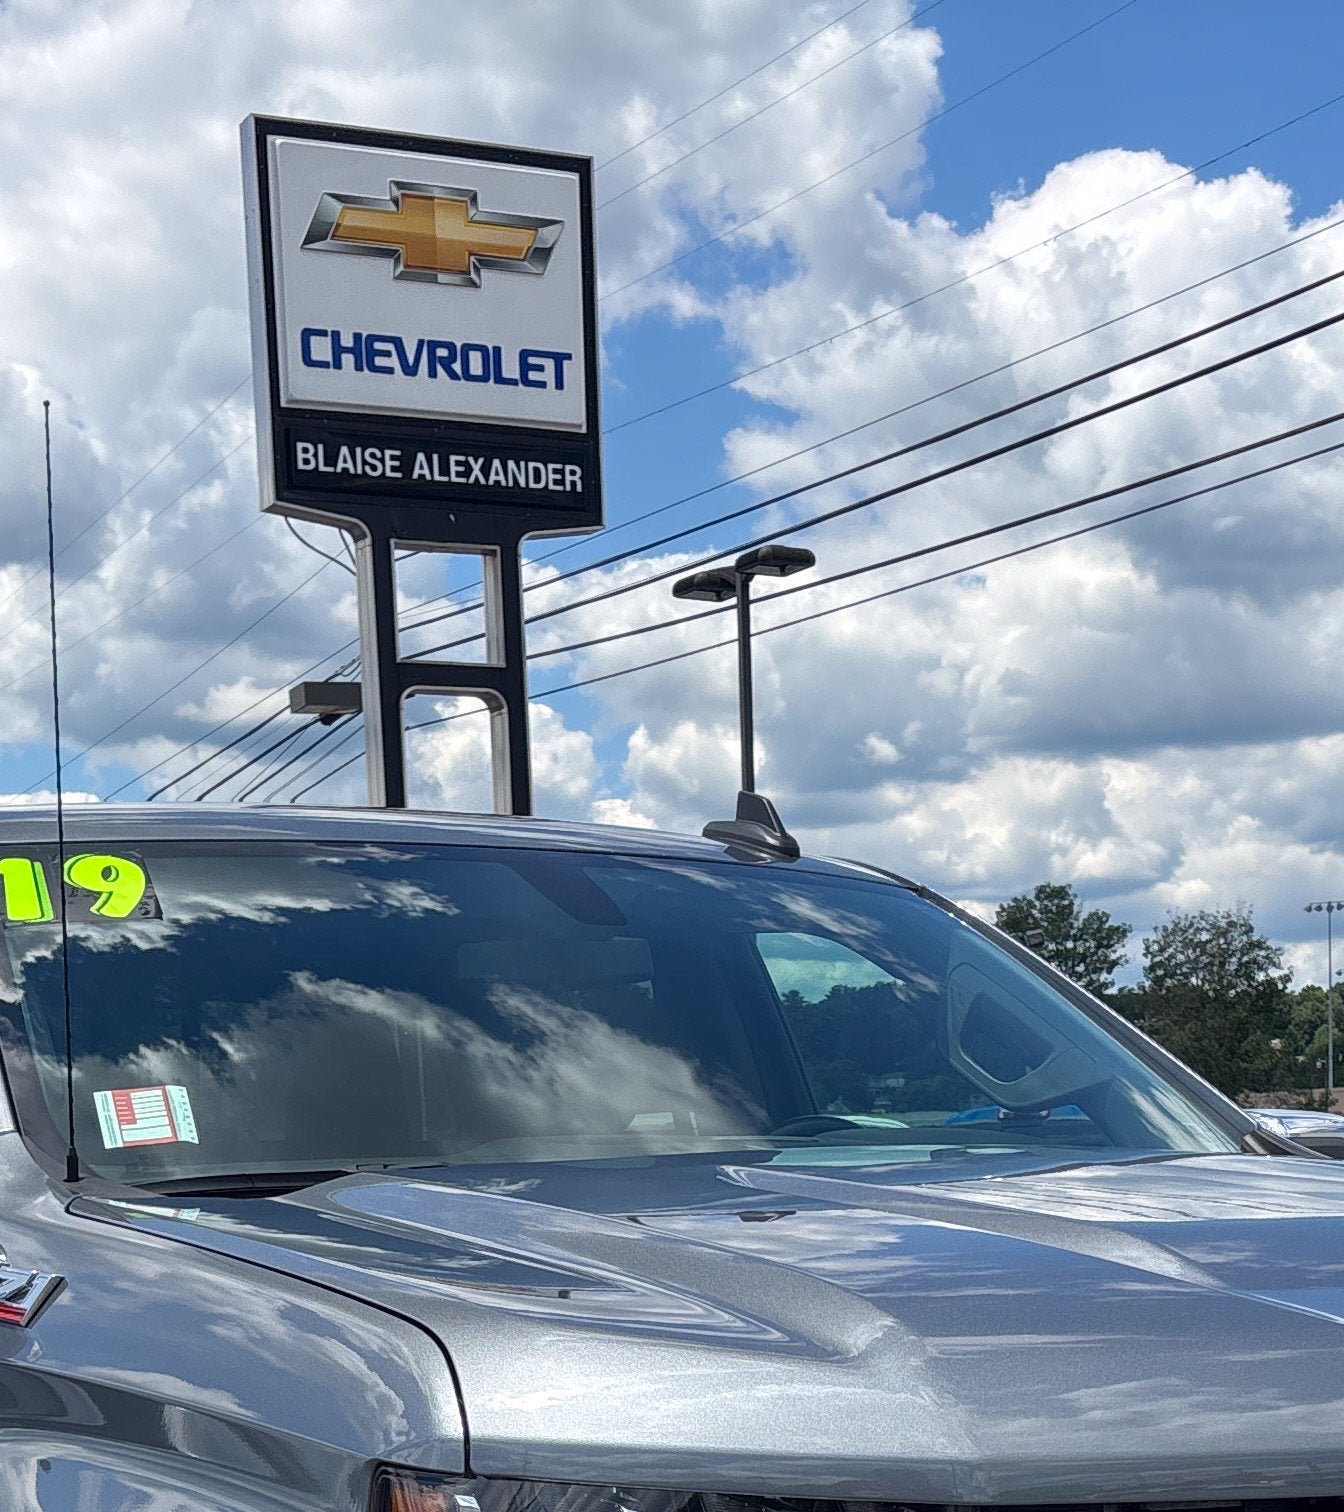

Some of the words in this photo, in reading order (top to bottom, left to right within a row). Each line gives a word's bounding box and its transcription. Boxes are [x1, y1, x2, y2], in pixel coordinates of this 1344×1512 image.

[300, 328, 573, 390] CHEVROLET
[296, 442, 402, 479] BLAISE
[411, 452, 583, 493] ALEXANDER
